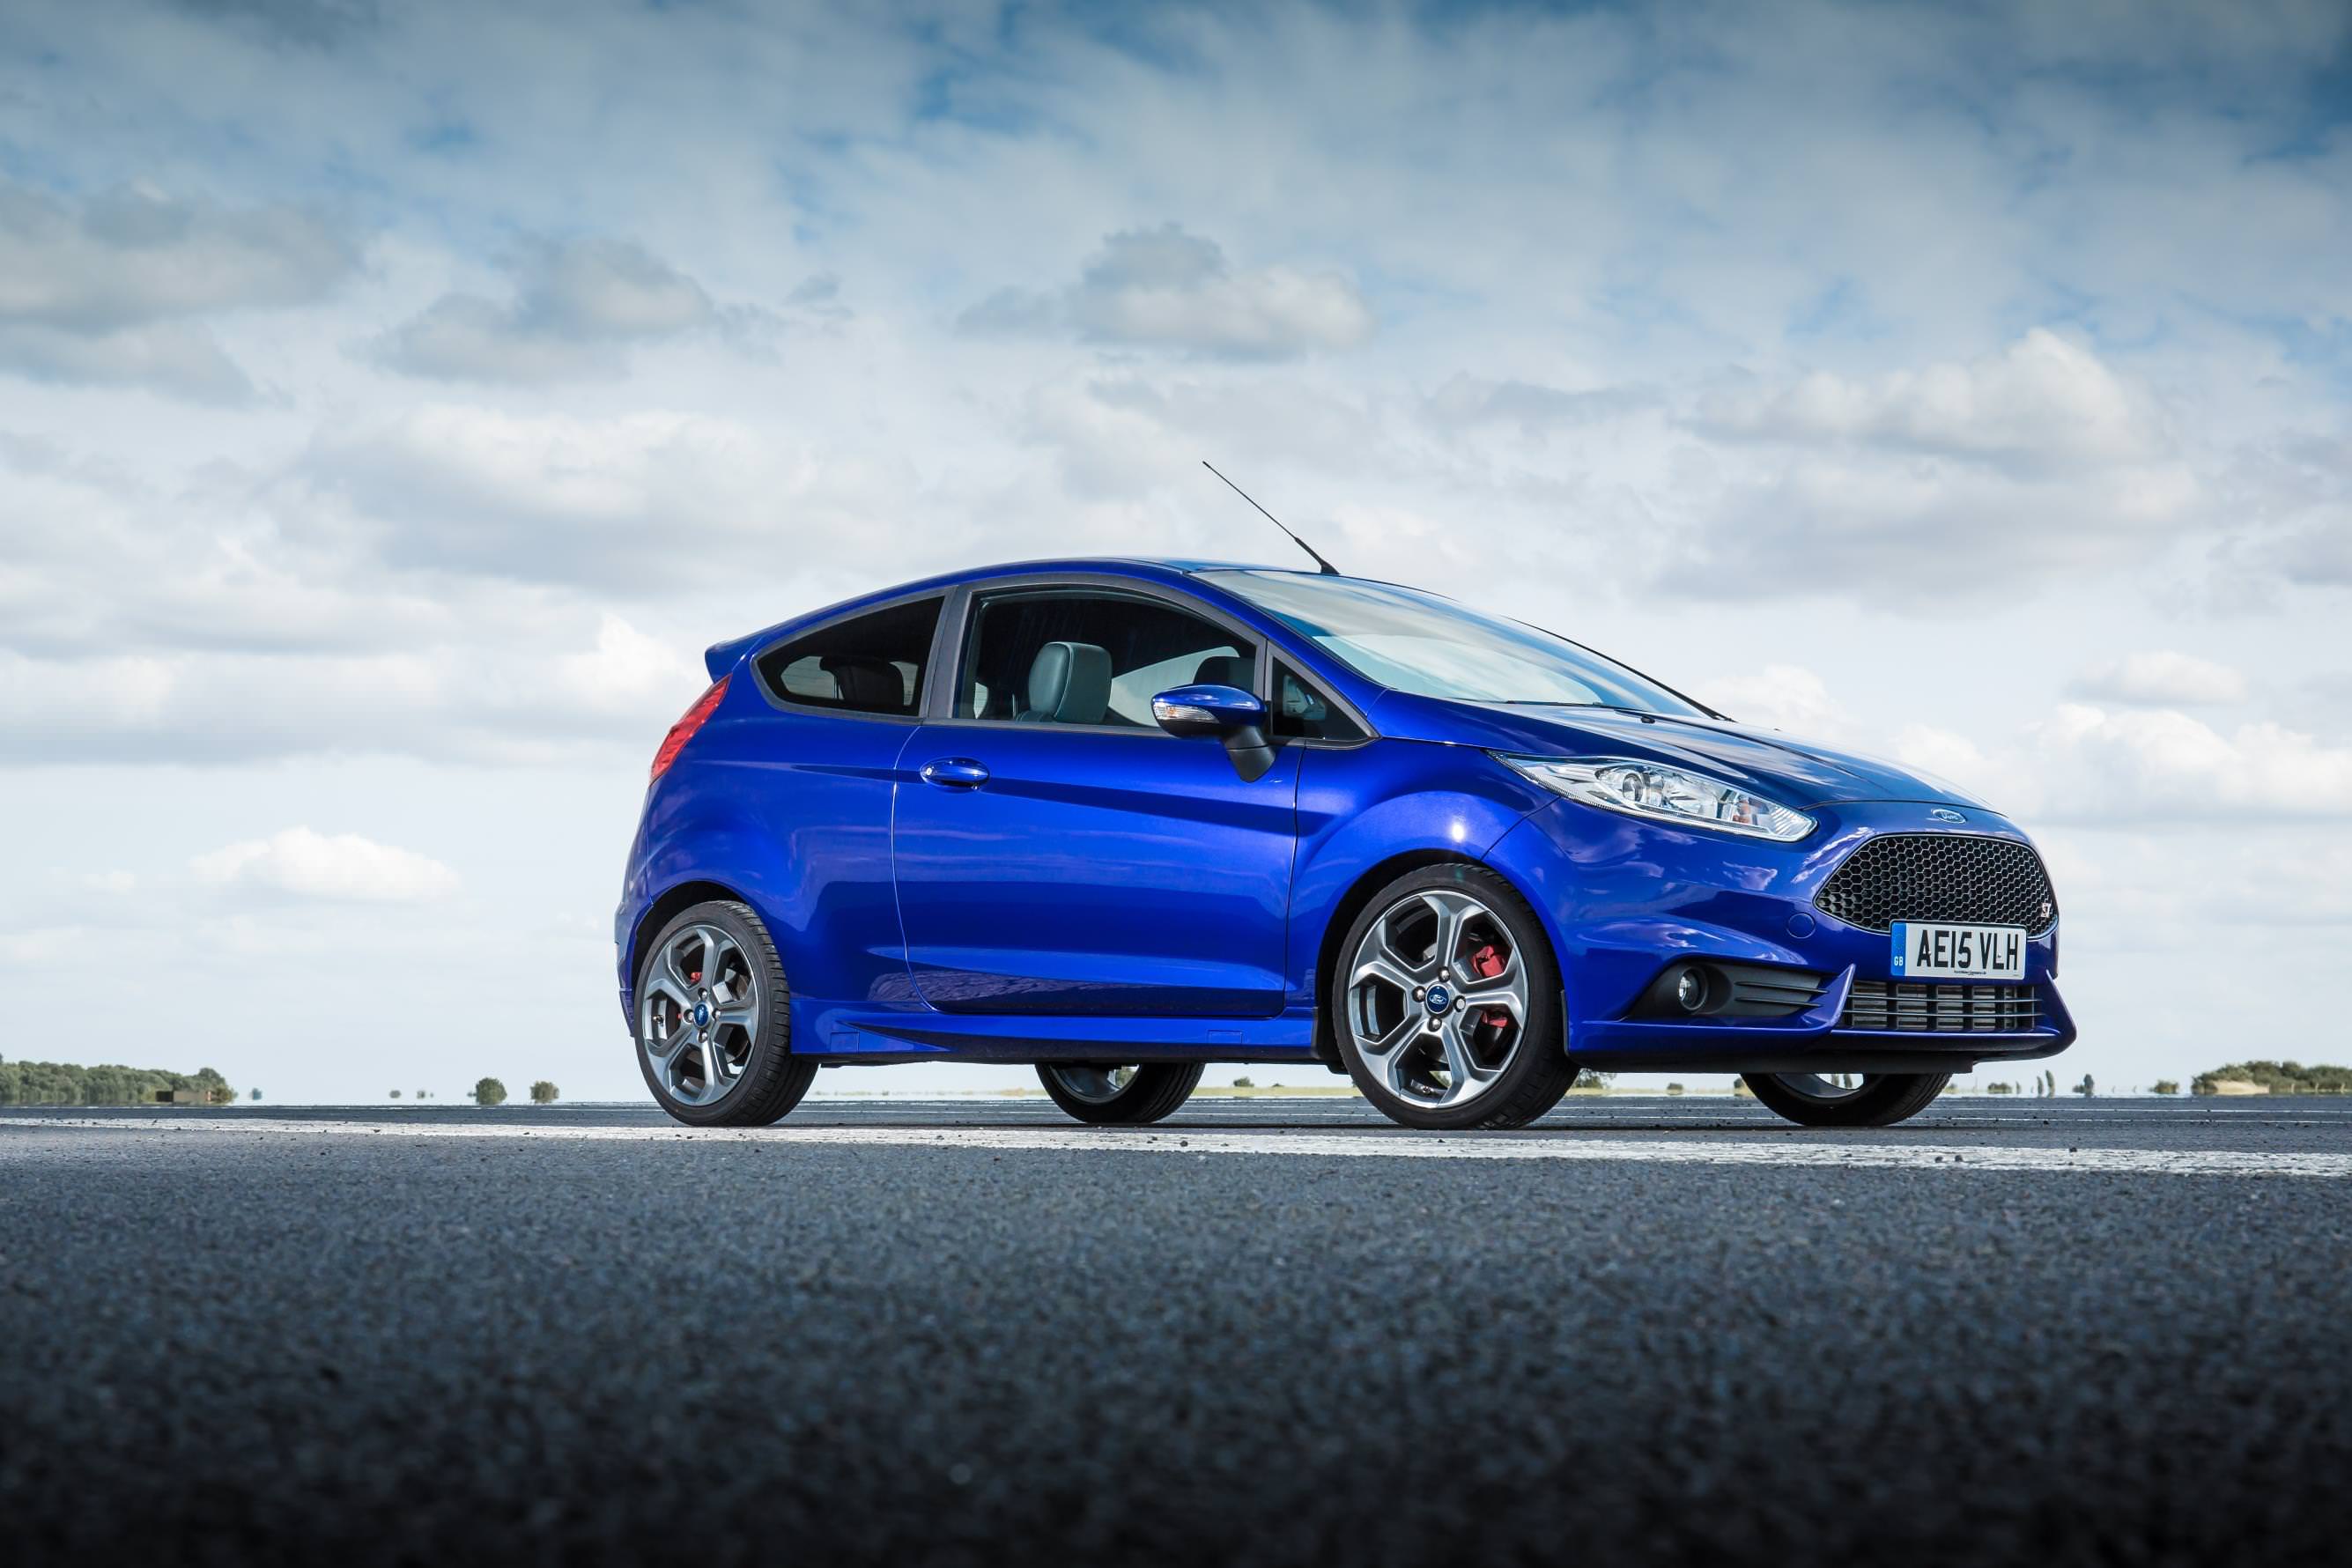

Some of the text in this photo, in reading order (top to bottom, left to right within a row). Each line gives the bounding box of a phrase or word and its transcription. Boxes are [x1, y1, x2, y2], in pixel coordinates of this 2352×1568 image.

[1894, 956, 1904, 966] GB
[1916, 929, 2019, 971] AE15 VLH
